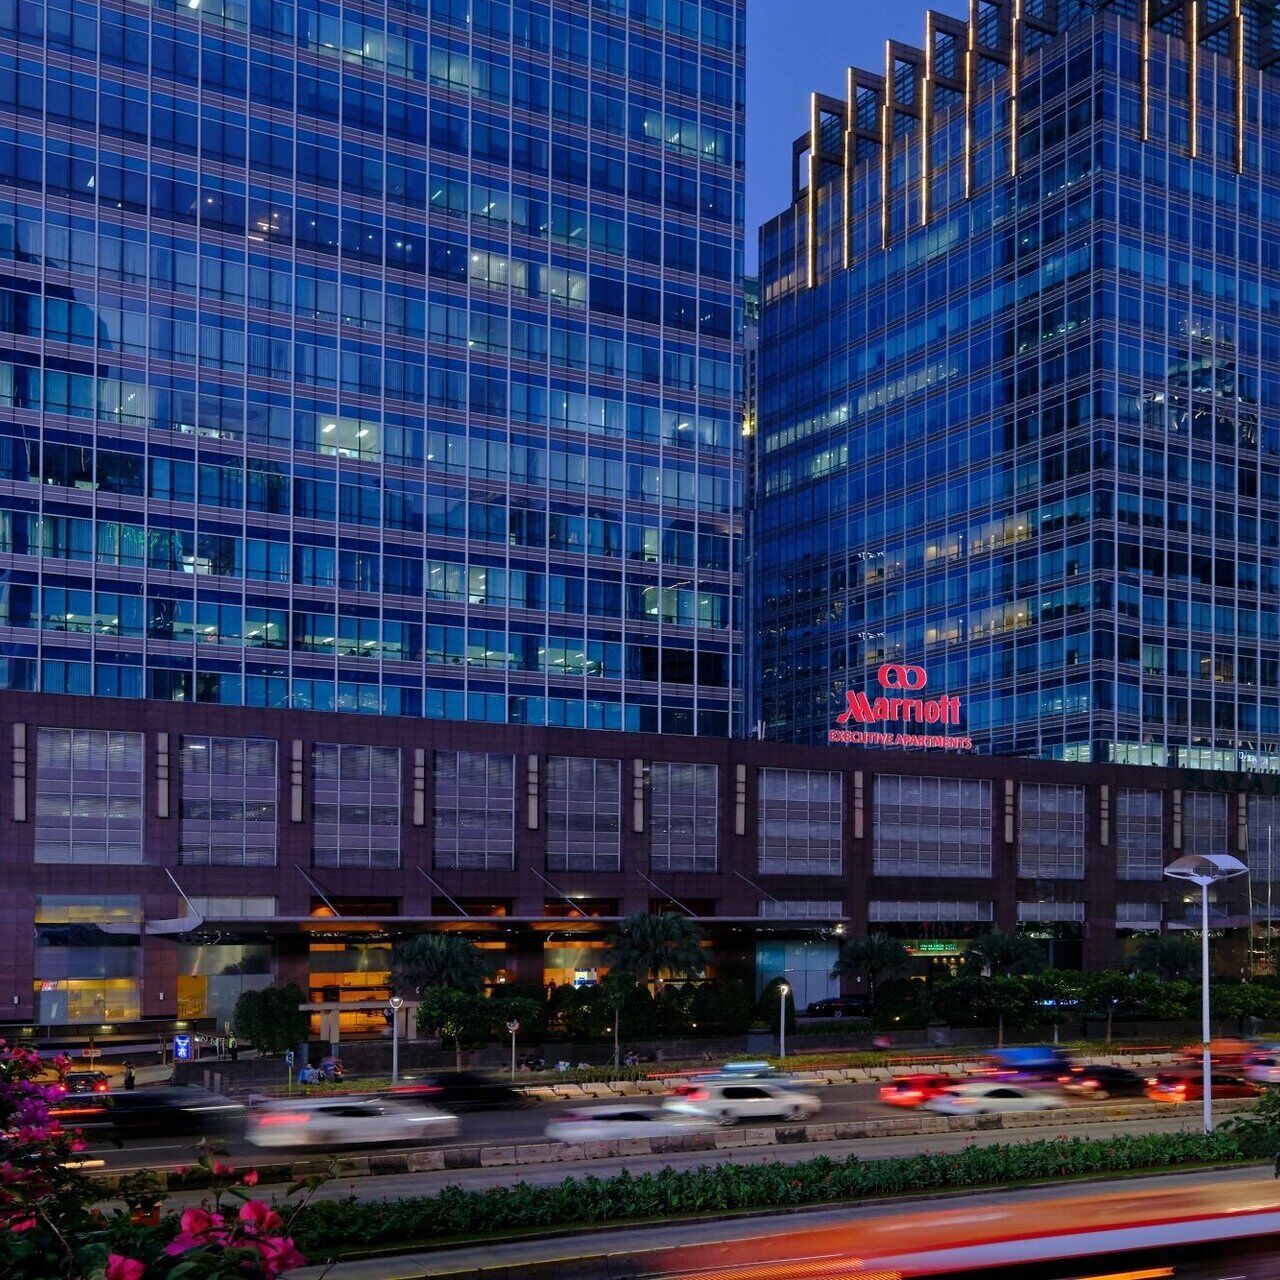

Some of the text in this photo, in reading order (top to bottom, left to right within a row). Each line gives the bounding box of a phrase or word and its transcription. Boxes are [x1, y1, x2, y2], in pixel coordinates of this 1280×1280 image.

[837, 690, 961, 724] Marriott
[829, 730, 972, 749] EXECUTIVE APARTMENTS
